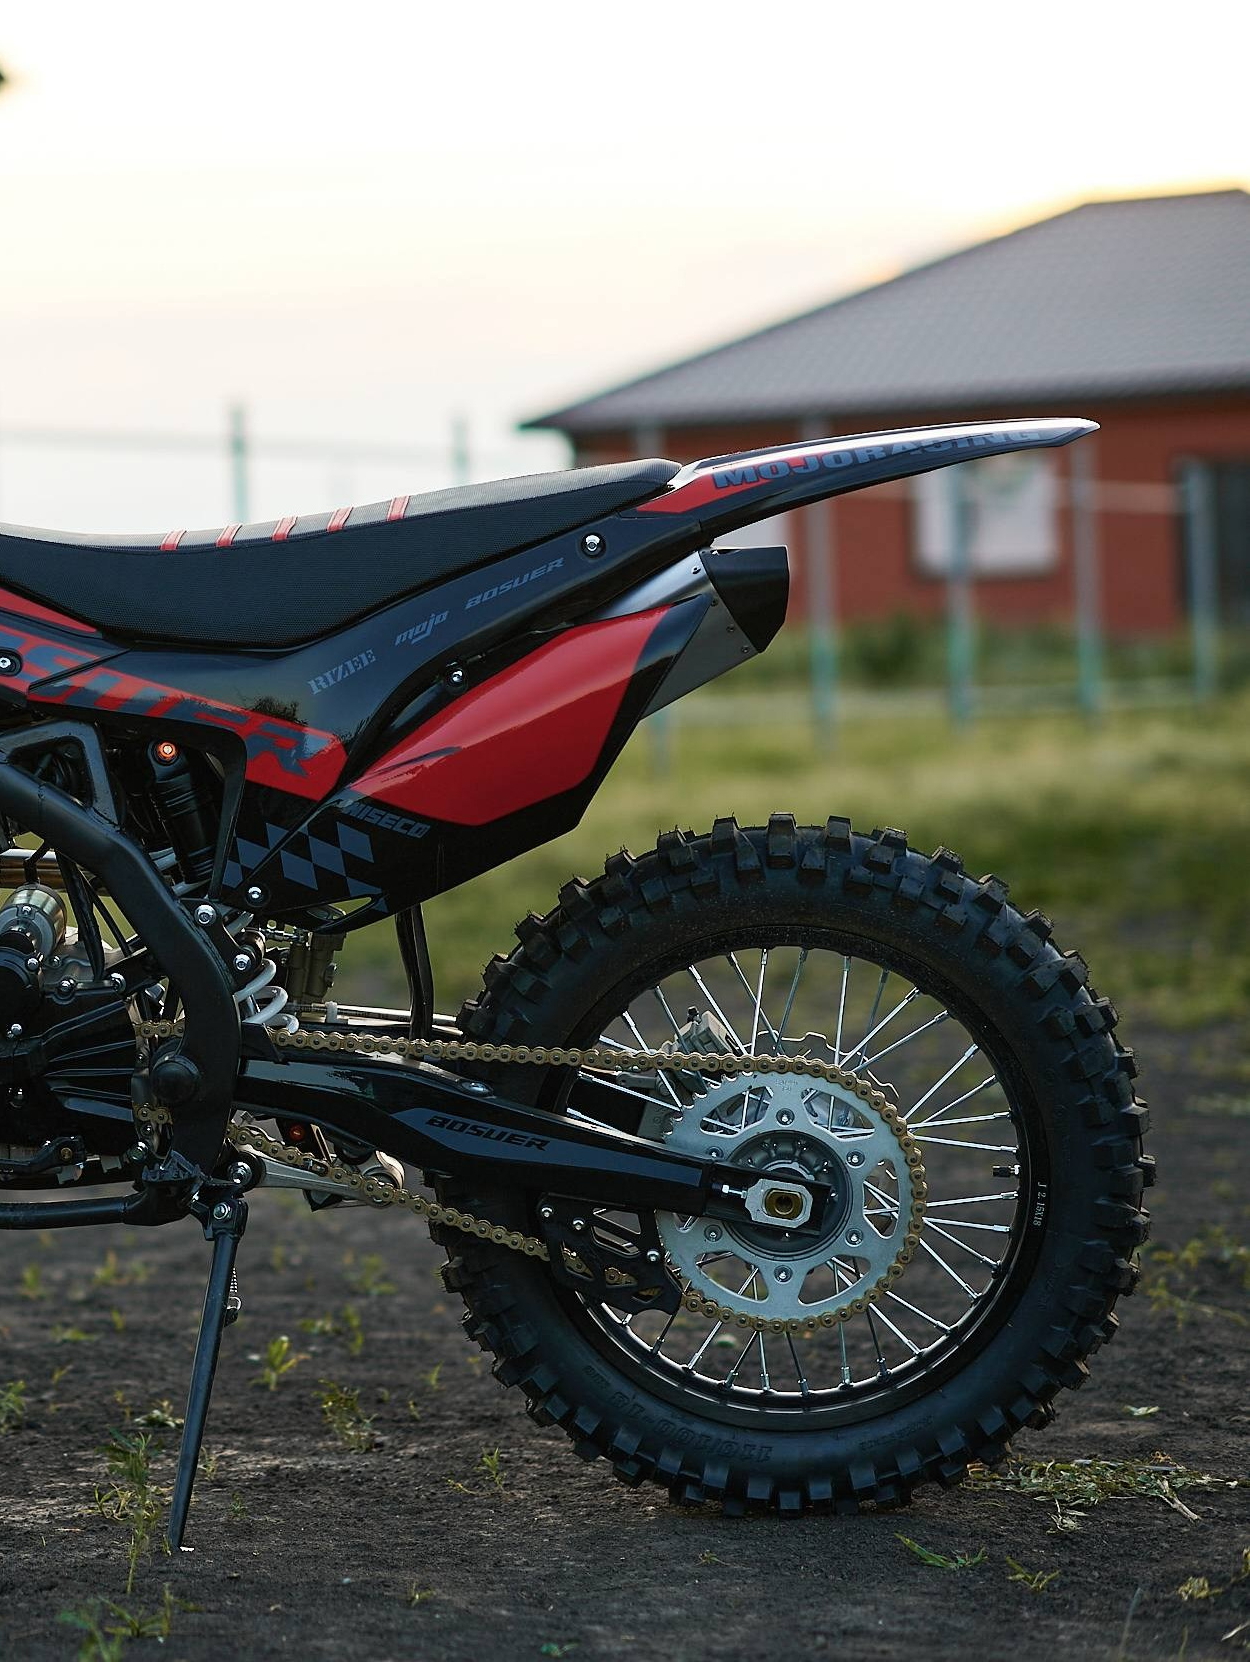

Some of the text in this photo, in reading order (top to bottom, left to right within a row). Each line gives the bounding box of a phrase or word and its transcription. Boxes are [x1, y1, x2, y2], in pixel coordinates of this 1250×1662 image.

[464, 557, 565, 610] BOSUER
[395, 611, 449, 646] mojo
[307, 648, 376, 695] RIZEE
[425, 1115, 550, 1151] BOSUER
